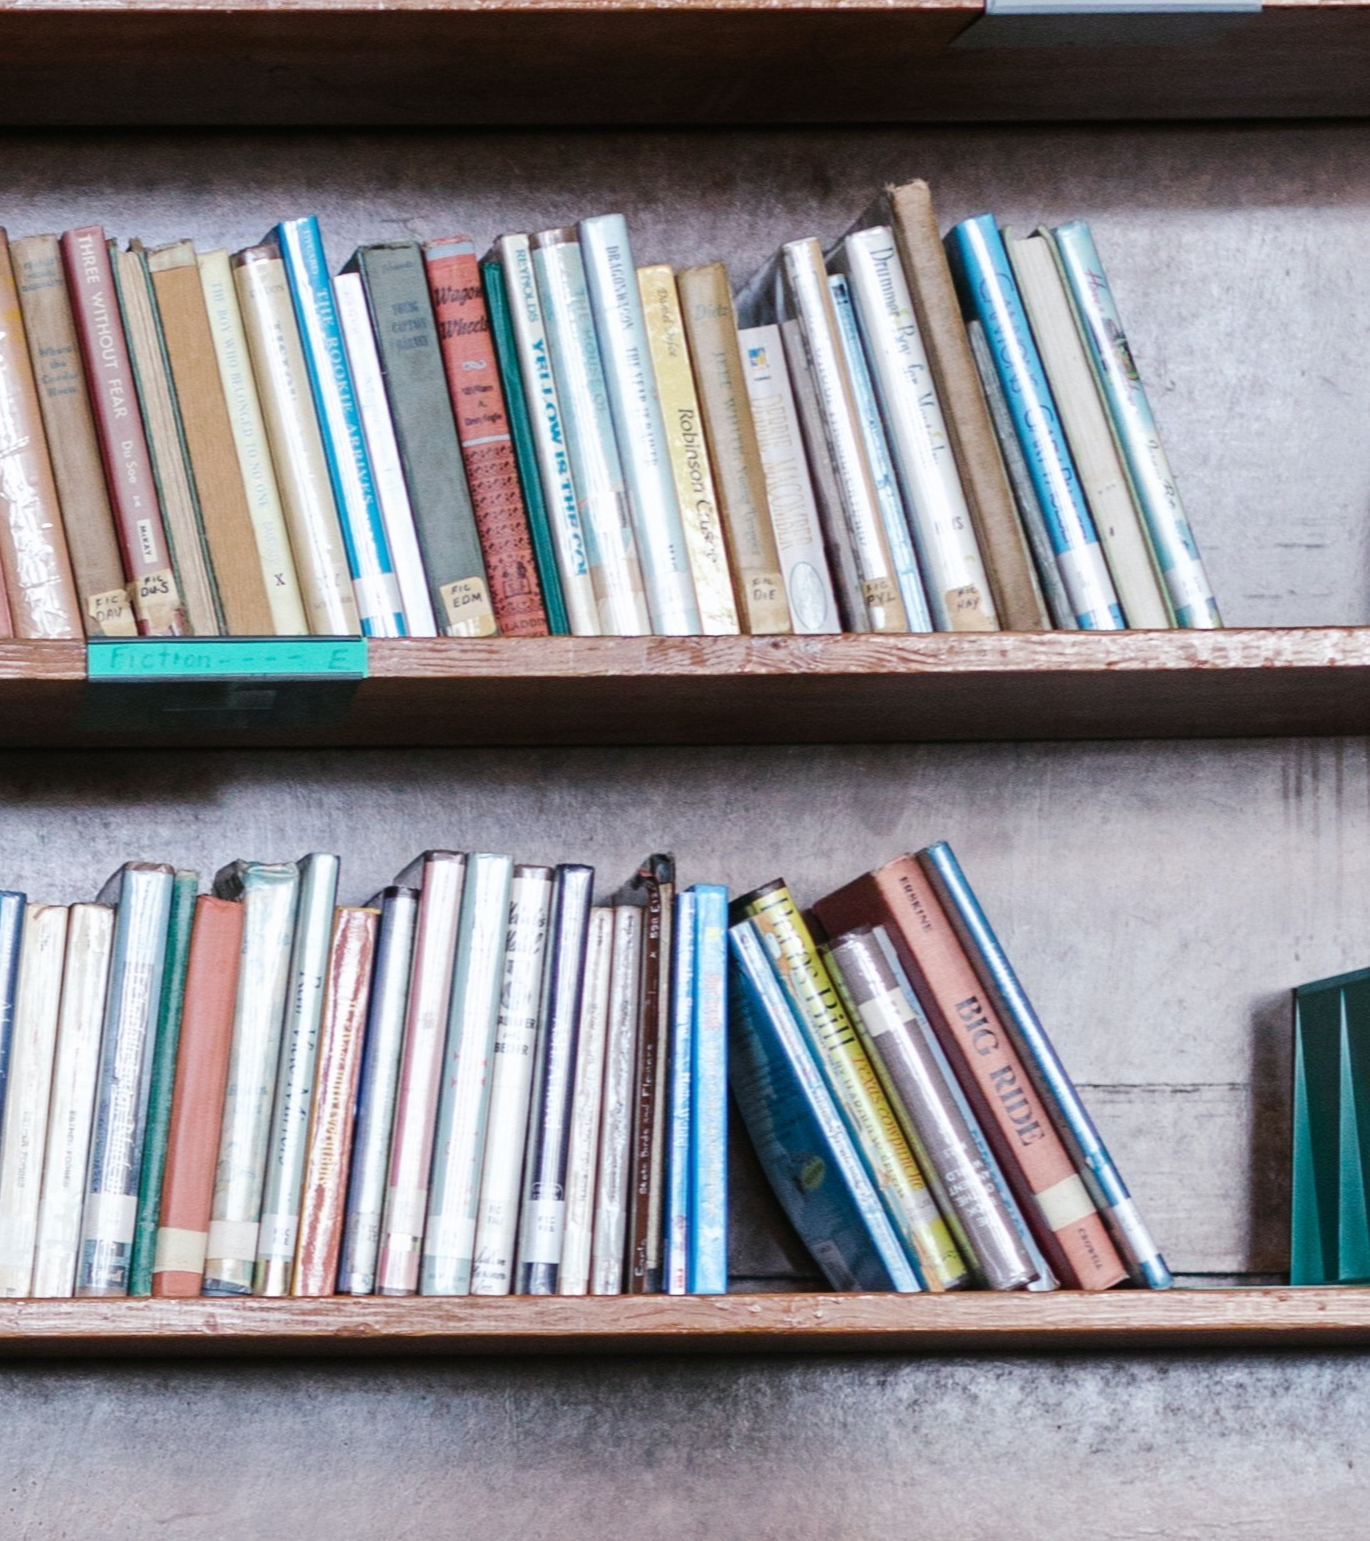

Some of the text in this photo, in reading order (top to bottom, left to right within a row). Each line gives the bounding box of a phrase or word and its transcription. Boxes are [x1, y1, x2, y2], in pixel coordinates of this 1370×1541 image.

[76, 232, 129, 419] THREE WITHOUT FEAR
[676, 406, 708, 494] Robinson
[109, 647, 212, 669] Fiction
[954, 996, 1046, 1147] BIG RIDE
